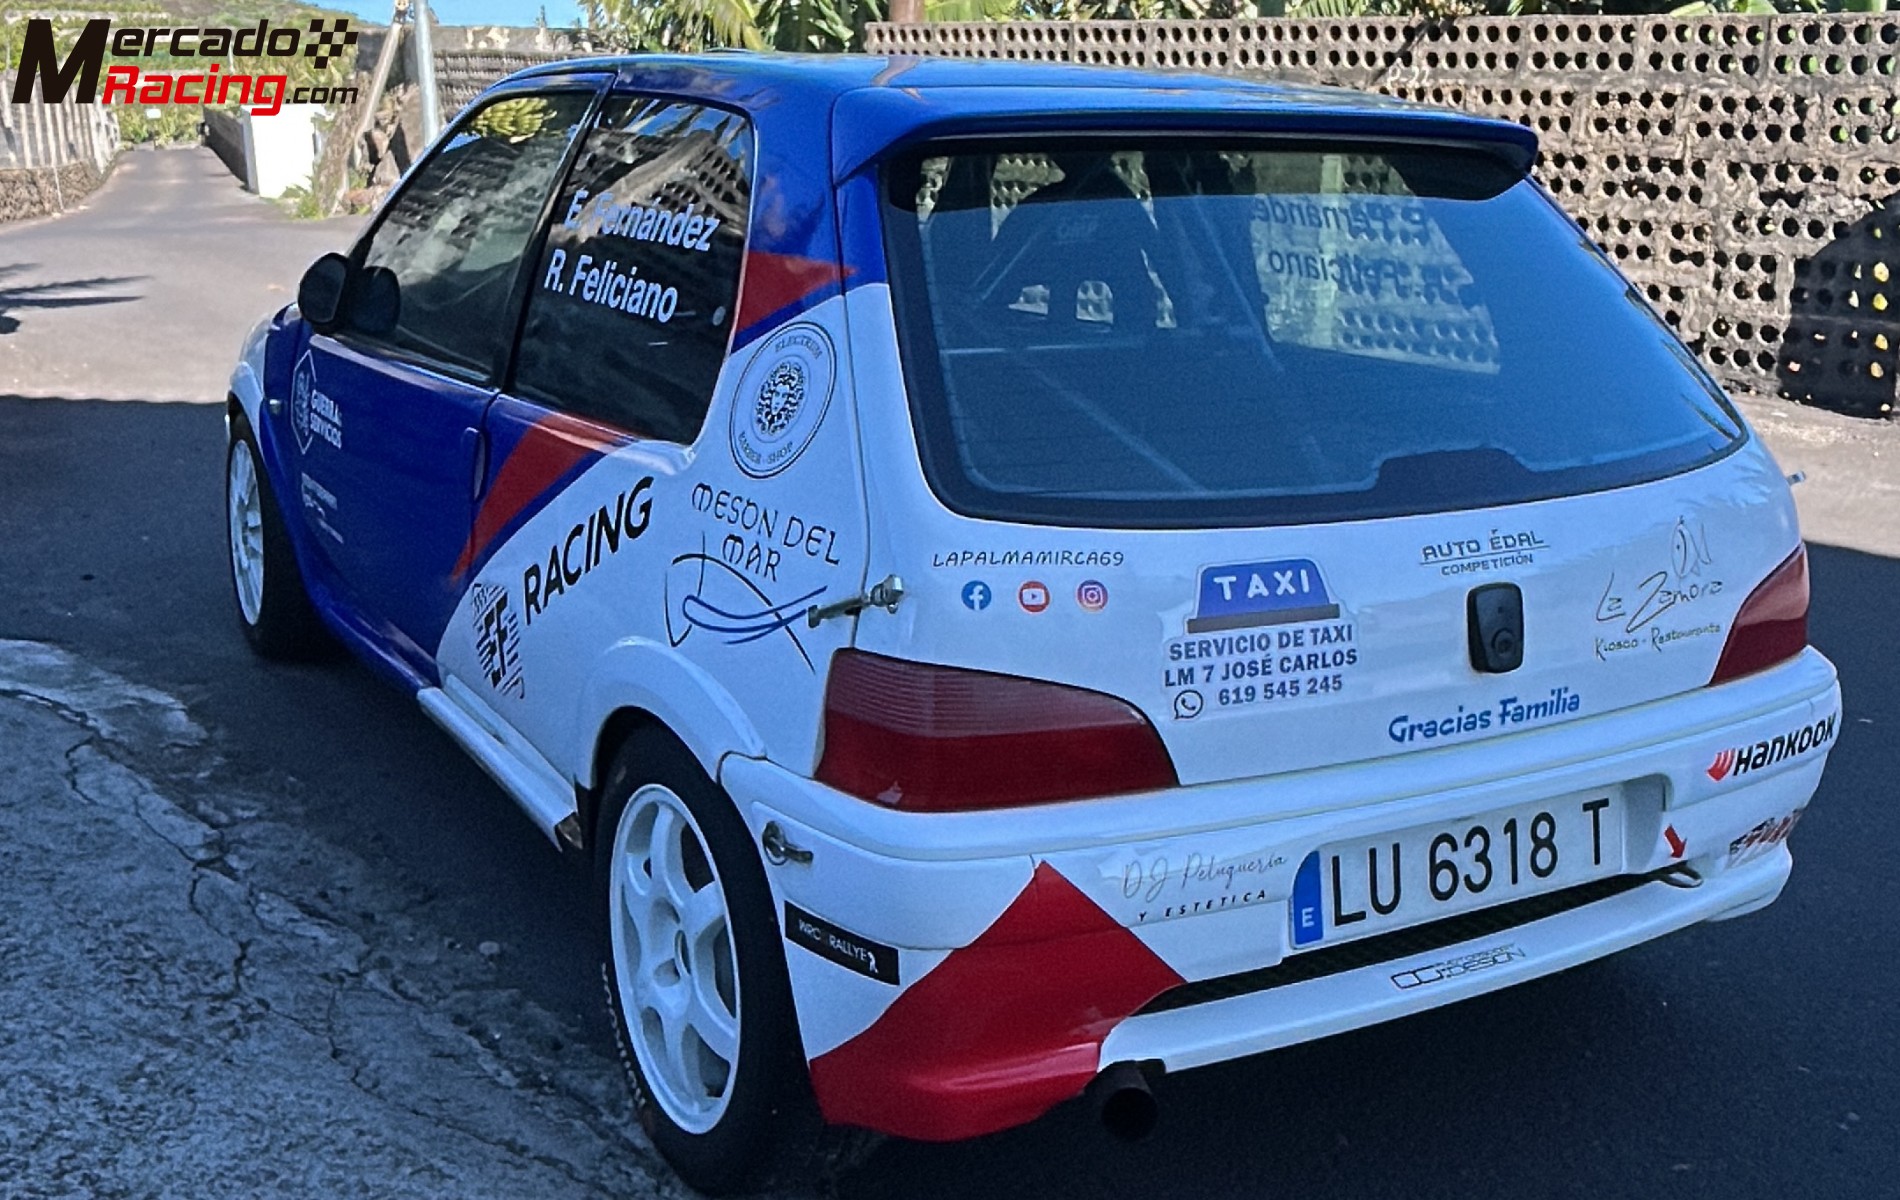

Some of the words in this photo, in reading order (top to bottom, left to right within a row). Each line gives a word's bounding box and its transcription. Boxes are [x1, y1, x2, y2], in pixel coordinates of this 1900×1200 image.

[590, 191, 721, 251] Fernández
[544, 249, 567, 292] R.
[569, 254, 678, 323] Feliciano
[691, 482, 778, 538] MESON
[783, 516, 841, 565] DEL
[523, 476, 654, 626] RACING
[722, 534, 781, 582] MAR
[932, 549, 1125, 568] LAPALMAMIRCA69
[1422, 538, 1481, 561] AUTO
[1489, 528, 1544, 550] ÉDAL
[1441, 551, 1534, 576] COMPETICIÓN
[1213, 569, 1311, 601] TAXI
[1626, 570, 1724, 634] Zamora
[1169, 632, 1271, 661] SERVICIO
[1278, 630, 1305, 649] DE
[1310, 624, 1353, 646] TAXI
[1164, 667, 1195, 688] LM
[1202, 665, 1215, 684] 7
[1221, 653, 1273, 681] JOSÉ
[1279, 648, 1358, 674] CARLOS
[1218, 685, 1257, 706] 619
[1263, 679, 1300, 701] 545
[1306, 674, 1344, 696] 245
[1388, 704, 1493, 743] Gracias
[1498, 686, 1581, 727] Familia
[1330, 842, 1401, 926] LU
[1428, 811, 1559, 901] 6318
[1582, 797, 1610, 866] T
[1138, 911, 1147, 923] Y
[1164, 889, 1266, 918] ESTETICA
[1301, 907, 1316, 929] E
